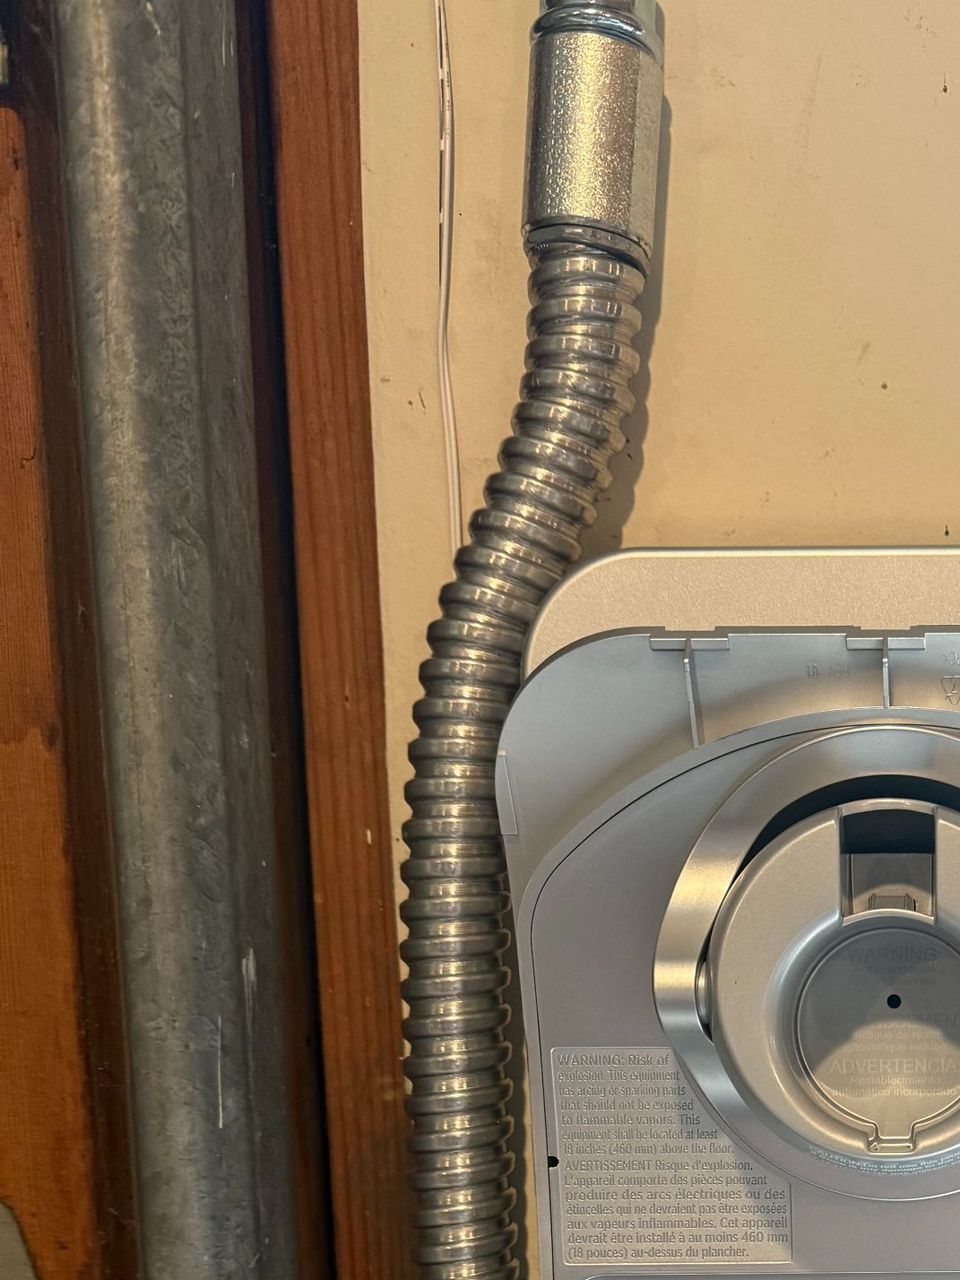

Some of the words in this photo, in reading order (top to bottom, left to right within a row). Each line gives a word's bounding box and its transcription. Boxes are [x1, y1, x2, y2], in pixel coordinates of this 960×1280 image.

[558, 1054, 624, 1066] WARNING:
[628, 1054, 653, 1066] Risk
[657, 1054, 670, 1066] of
[607, 1070, 627, 1081] This
[630, 1070, 681, 1081] equipment
[559, 1085, 575, 1096] has
[578, 1085, 606, 1098] arcing
[608, 1088, 617, 1096] or
[620, 1085, 660, 1098] sparking
[662, 1085, 686, 1098] parts
[560, 1100, 580, 1111] that
[583, 1100, 616, 1111] should
[619, 1100, 635, 1111] not
[638, 1100, 650, 1111] be
[653, 1100, 694, 1111] exposed
[561, 1114, 573, 1126] to
[576, 1114, 633, 1126] flammable
[636, 1116, 675, 1126] vapors.
[678, 1114, 700, 1126] This
[562, 1129, 610, 1142] equipment
[613, 1129, 633, 1141] shall
[636, 1129, 647, 1141] be
[650, 1129, 683, 1141] located
[685, 1130, 695, 1139] at
[697, 1129, 718, 1139] least
[563, 1143, 573, 1155] 18
[575, 1143, 606, 1155] inches
[608, 1143, 632, 1155] (460
[635, 1143, 656, 1155] mm)
[660, 1143, 689, 1155] above
[691, 1143, 707, 1155] the
[709, 1143, 734, 1155] floor.
[655, 1159, 689, 1172] Risque
[618, 1174, 668, 1187] comporte
[670, 1174, 688, 1185] des
[725, 1176, 767, 1187] pouvant
[566, 1189, 618, 1202] produire
[622, 1189, 643, 1200] des
[646, 1191, 672, 1200] arcs
[745, 1190, 760, 1199] ou
[764, 1188, 785, 1199] des
[616, 1203, 631, 1215] qui
[634, 1205, 646, 1214] ne
[649, 1203, 696, 1214] devraient
[699, 1205, 716, 1215] pas
[567, 1220, 588, 1229] aux
[591, 1220, 636, 1231] vapeurs
[720, 1217, 739, 1228] Cet
[742, 1217, 788, 1229] appareil
[568, 1232, 607, 1243] devrait
[688, 1234, 702, 1242] au
[705, 1232, 738, 1242] moins
[741, 1232, 764, 1242] 460
[767, 1233, 788, 1242] mm
[568, 1247, 583, 1259] (18
[586, 1247, 628, 1260] pouces)
[631, 1246, 683, 1258] au-dessus
[685, 1246, 699, 1257] du
[701, 1246, 749, 1259] plancher.
